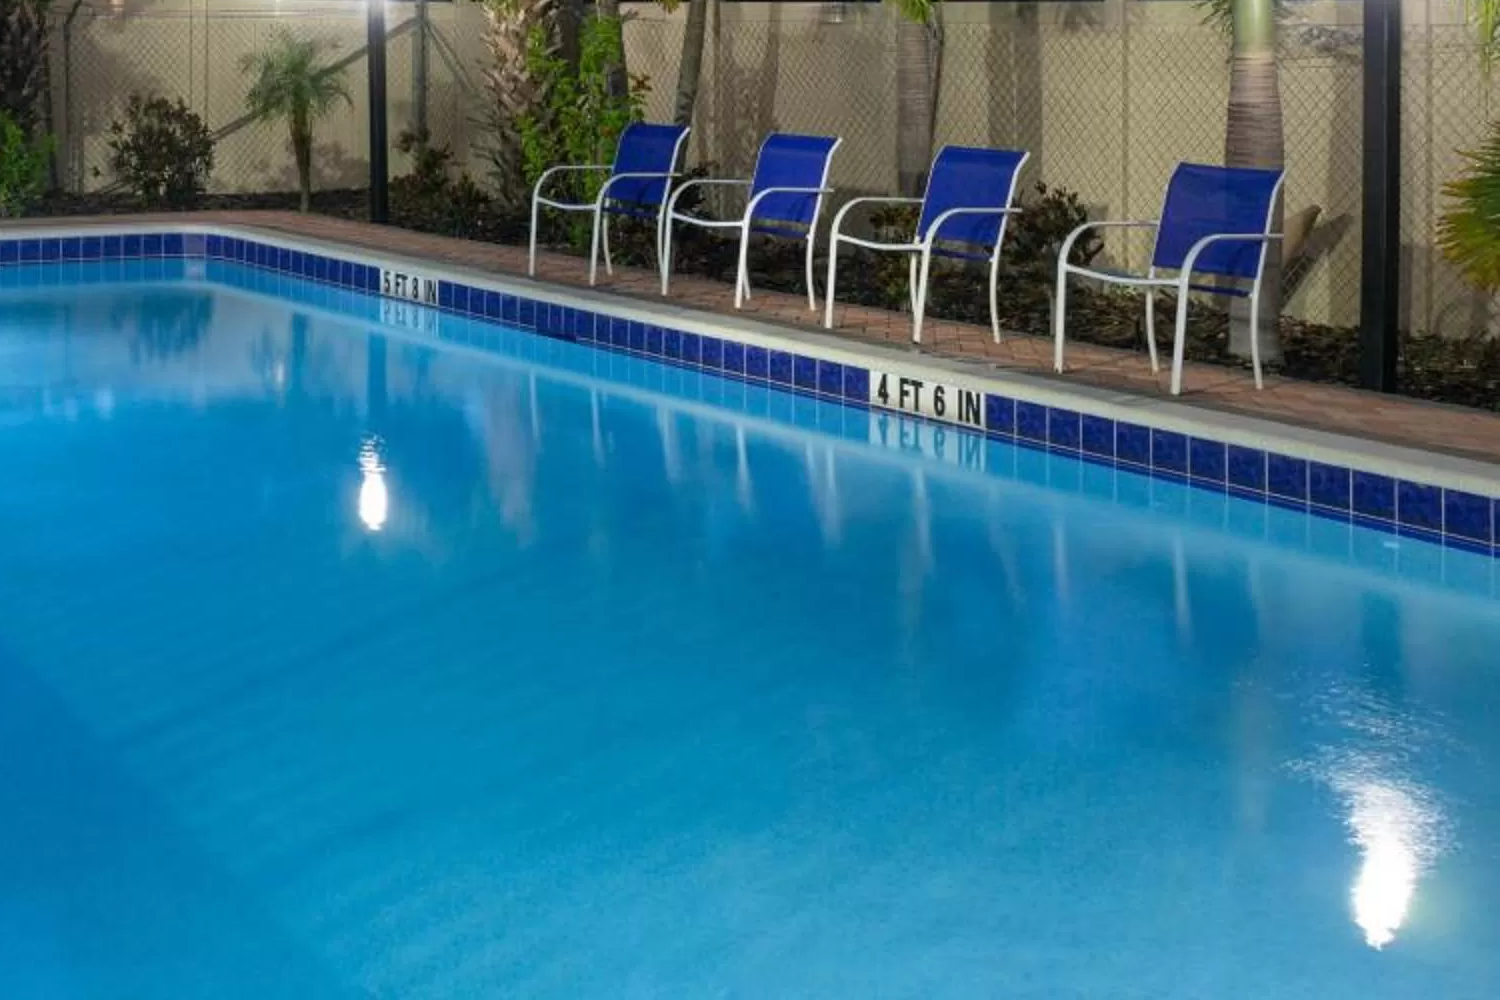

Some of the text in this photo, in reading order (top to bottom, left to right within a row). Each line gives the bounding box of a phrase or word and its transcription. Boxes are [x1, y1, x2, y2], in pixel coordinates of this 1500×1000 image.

[384, 271, 436, 303] 5 FT 8 IN
[878, 374, 980, 425] 4 FT 6 IN
